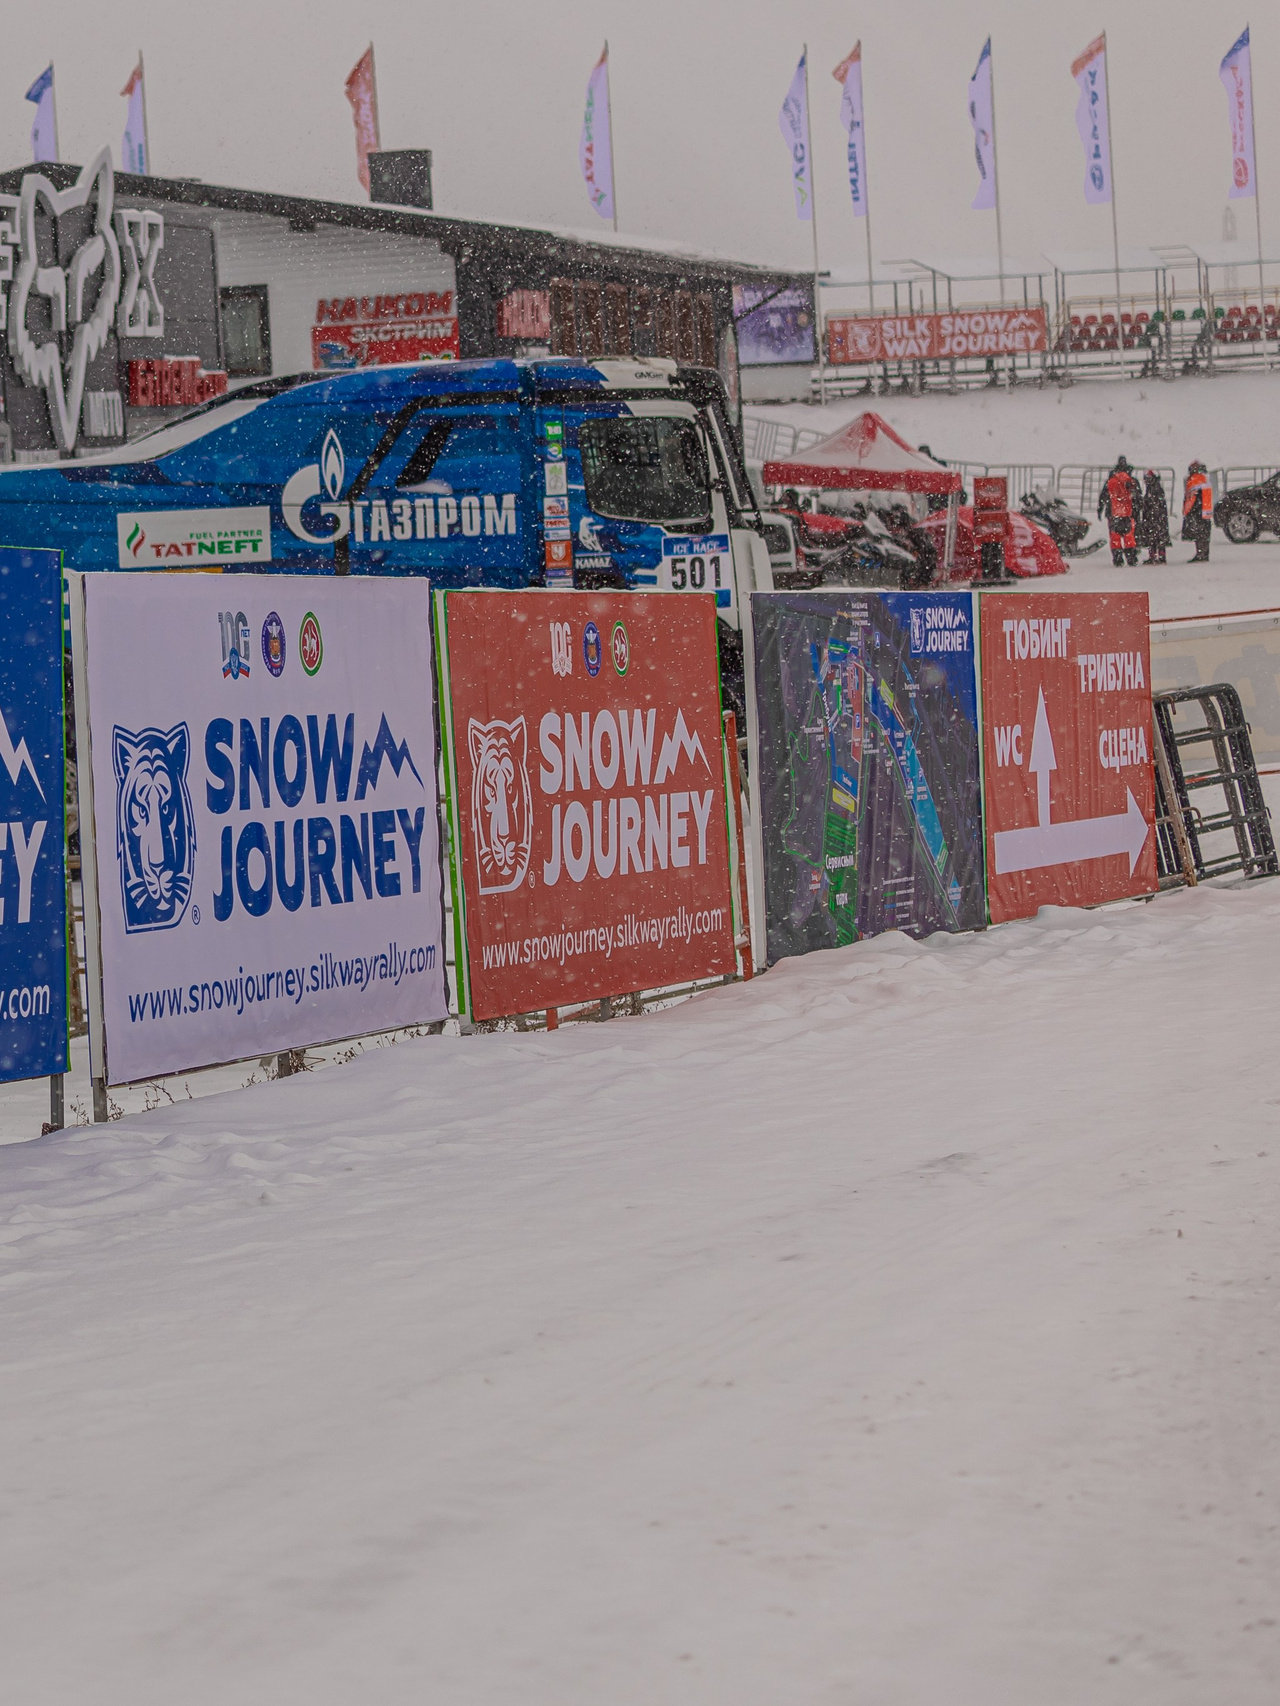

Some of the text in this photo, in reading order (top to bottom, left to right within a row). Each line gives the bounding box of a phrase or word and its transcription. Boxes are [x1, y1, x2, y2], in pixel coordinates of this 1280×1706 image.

[350, 321, 453, 343] ЭКСТРИМ
[882, 313, 1011, 339] SILK SNOW
[883, 330, 1041, 357] WAY JOURNEY
[150, 538, 263, 558] TATNEFT
[189, 529, 263, 540] FUEL PARTNER
[575, 557, 612, 569] KAMAZ
[671, 556, 721, 590] 501
[925, 607, 954, 629] SNOW
[1003, 618, 1070, 660] ТЮБИНГ
[925, 630, 969, 653] JOURNEY
[1077, 651, 1145, 693] ТРИБУНА
[205, 712, 355, 814] SNOW
[539, 708, 657, 795] SNOW
[994, 724, 1023, 767] WC
[1099, 726, 1148, 773] СЦЕНА
[543, 789, 715, 886] JOURNEY
[213, 806, 426, 922] JOURNEY
[482, 906, 723, 970] www.snowjourney.silkwayrally.com
[128, 941, 436, 1023] www.snowjourney.silkwayrally.com
